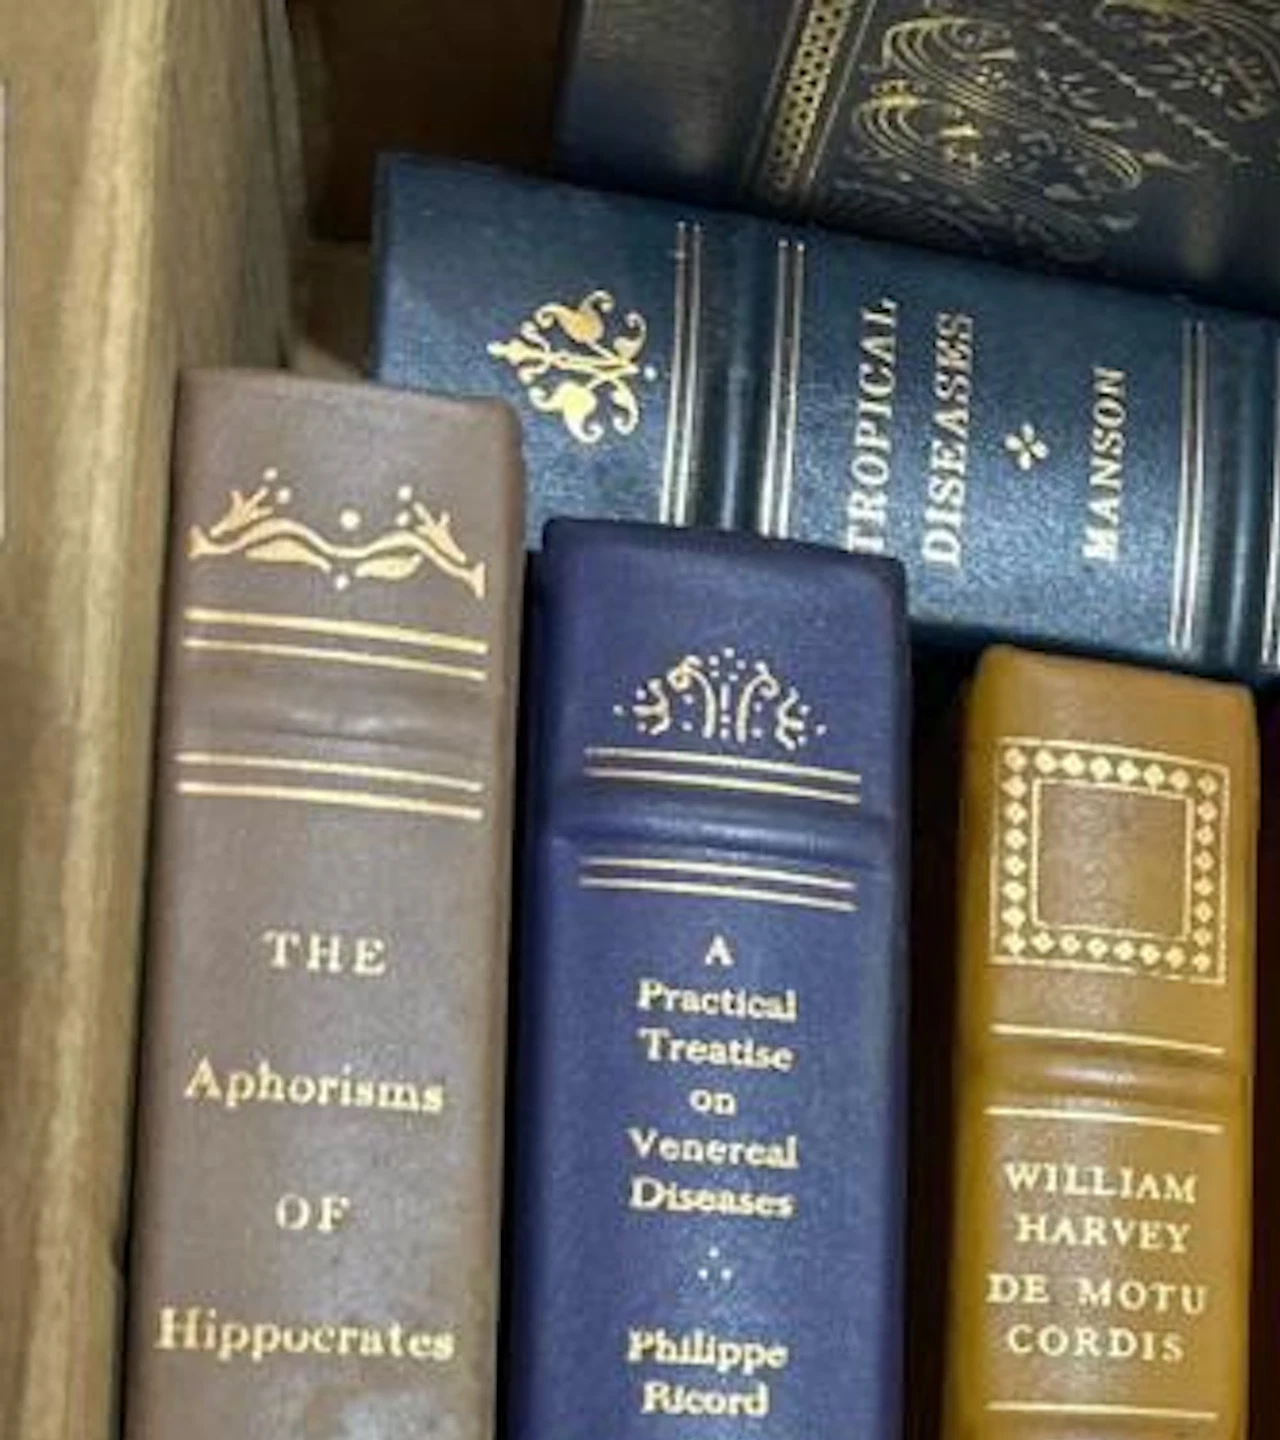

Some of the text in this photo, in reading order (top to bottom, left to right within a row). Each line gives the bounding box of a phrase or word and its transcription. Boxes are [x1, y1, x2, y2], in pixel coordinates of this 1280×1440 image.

[846, 297, 898, 553] TROPICAL
[922, 311, 973, 567] DISEASES
[1082, 366, 1126, 562] MANSON
[263, 930, 387, 975] THE
[704, 935, 733, 966] A
[637, 978, 798, 1021] Practical
[638, 1027, 795, 1070] Treatise
[184, 1058, 444, 1112] Aphorisms
[689, 1087, 737, 1116] on
[627, 1127, 798, 1168] Venereal
[628, 1176, 795, 1218] Diseases
[1002, 1162, 1198, 1204] WILLIAM
[275, 1194, 350, 1232] OF
[1015, 1213, 1191, 1252] HARVEY
[985, 1273, 1207, 1315] DE MOTU
[154, 1307, 454, 1361] Hippocrates
[626, 1328, 790, 1375] Philippe
[1007, 1323, 1184, 1363] CORDIS
